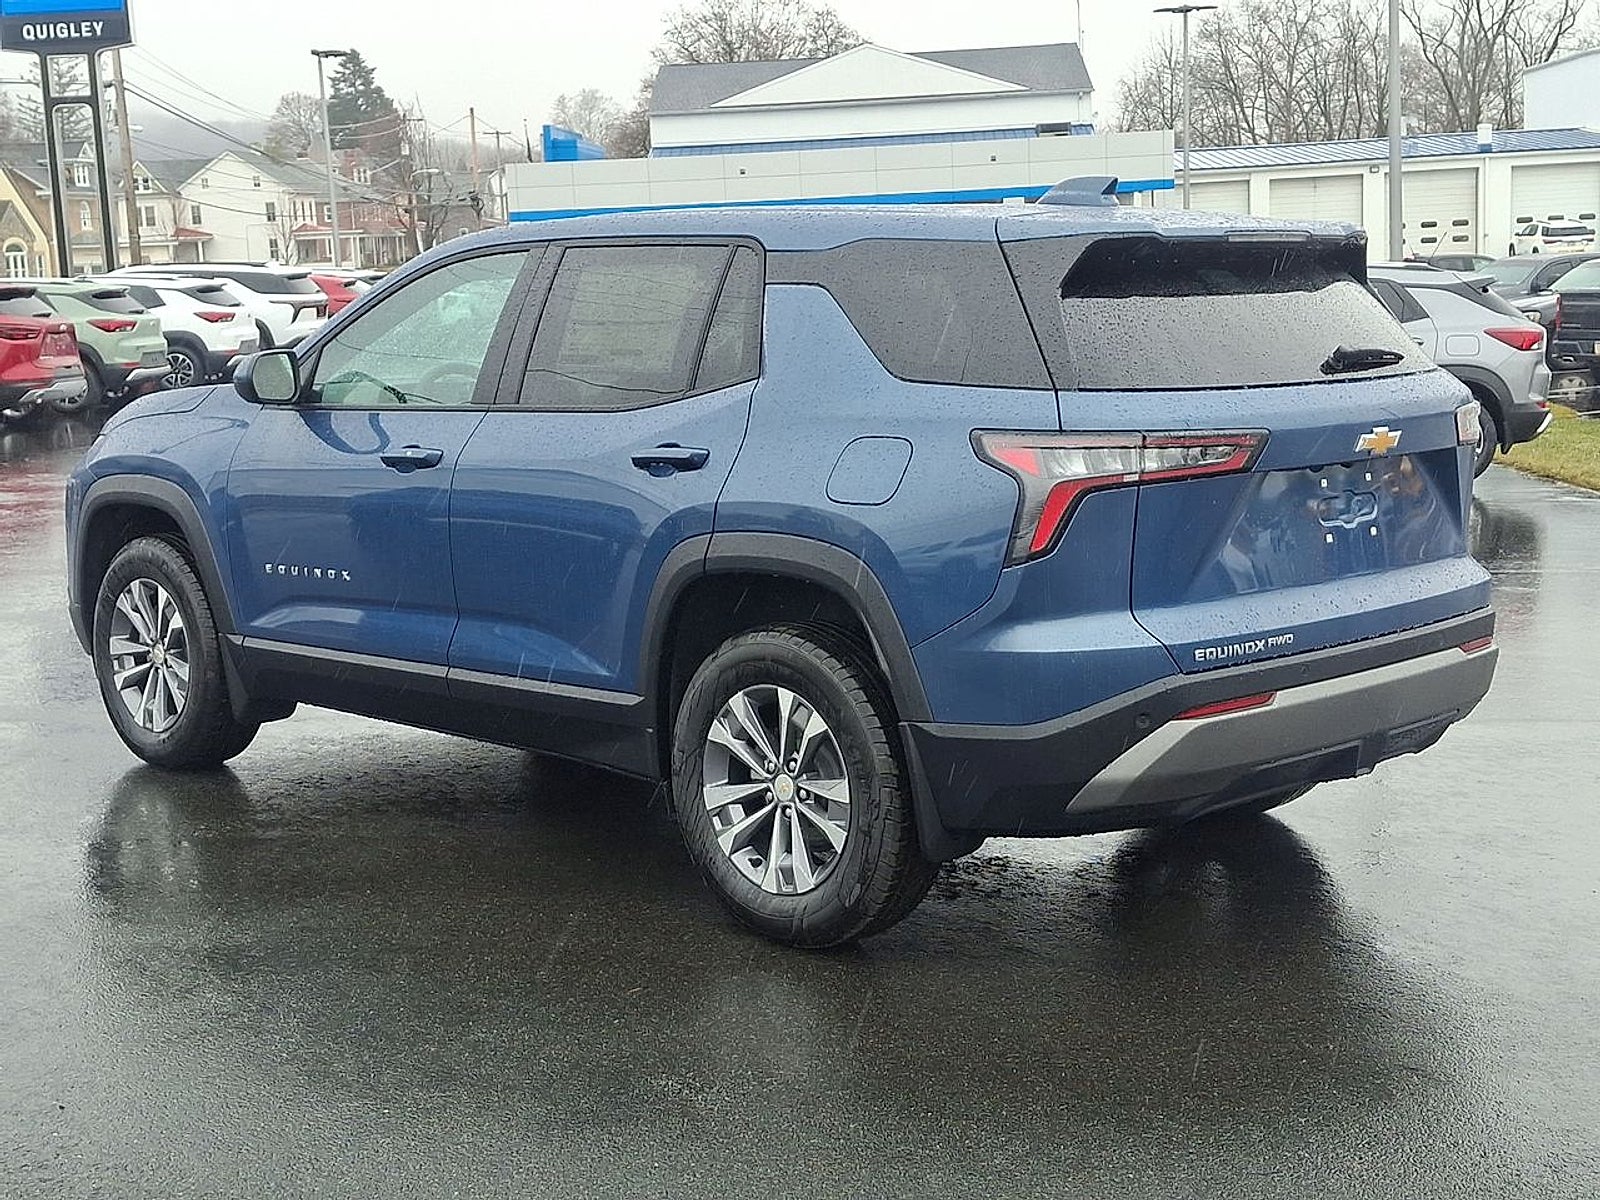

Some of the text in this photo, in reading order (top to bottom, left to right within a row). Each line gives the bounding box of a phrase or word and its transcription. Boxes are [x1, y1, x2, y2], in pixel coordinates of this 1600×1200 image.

[22, 21, 104, 41] QUIGLEY
[265, 563, 351, 581] EQUINOX
[1194, 633, 1294, 661] EQUINOX AWD
